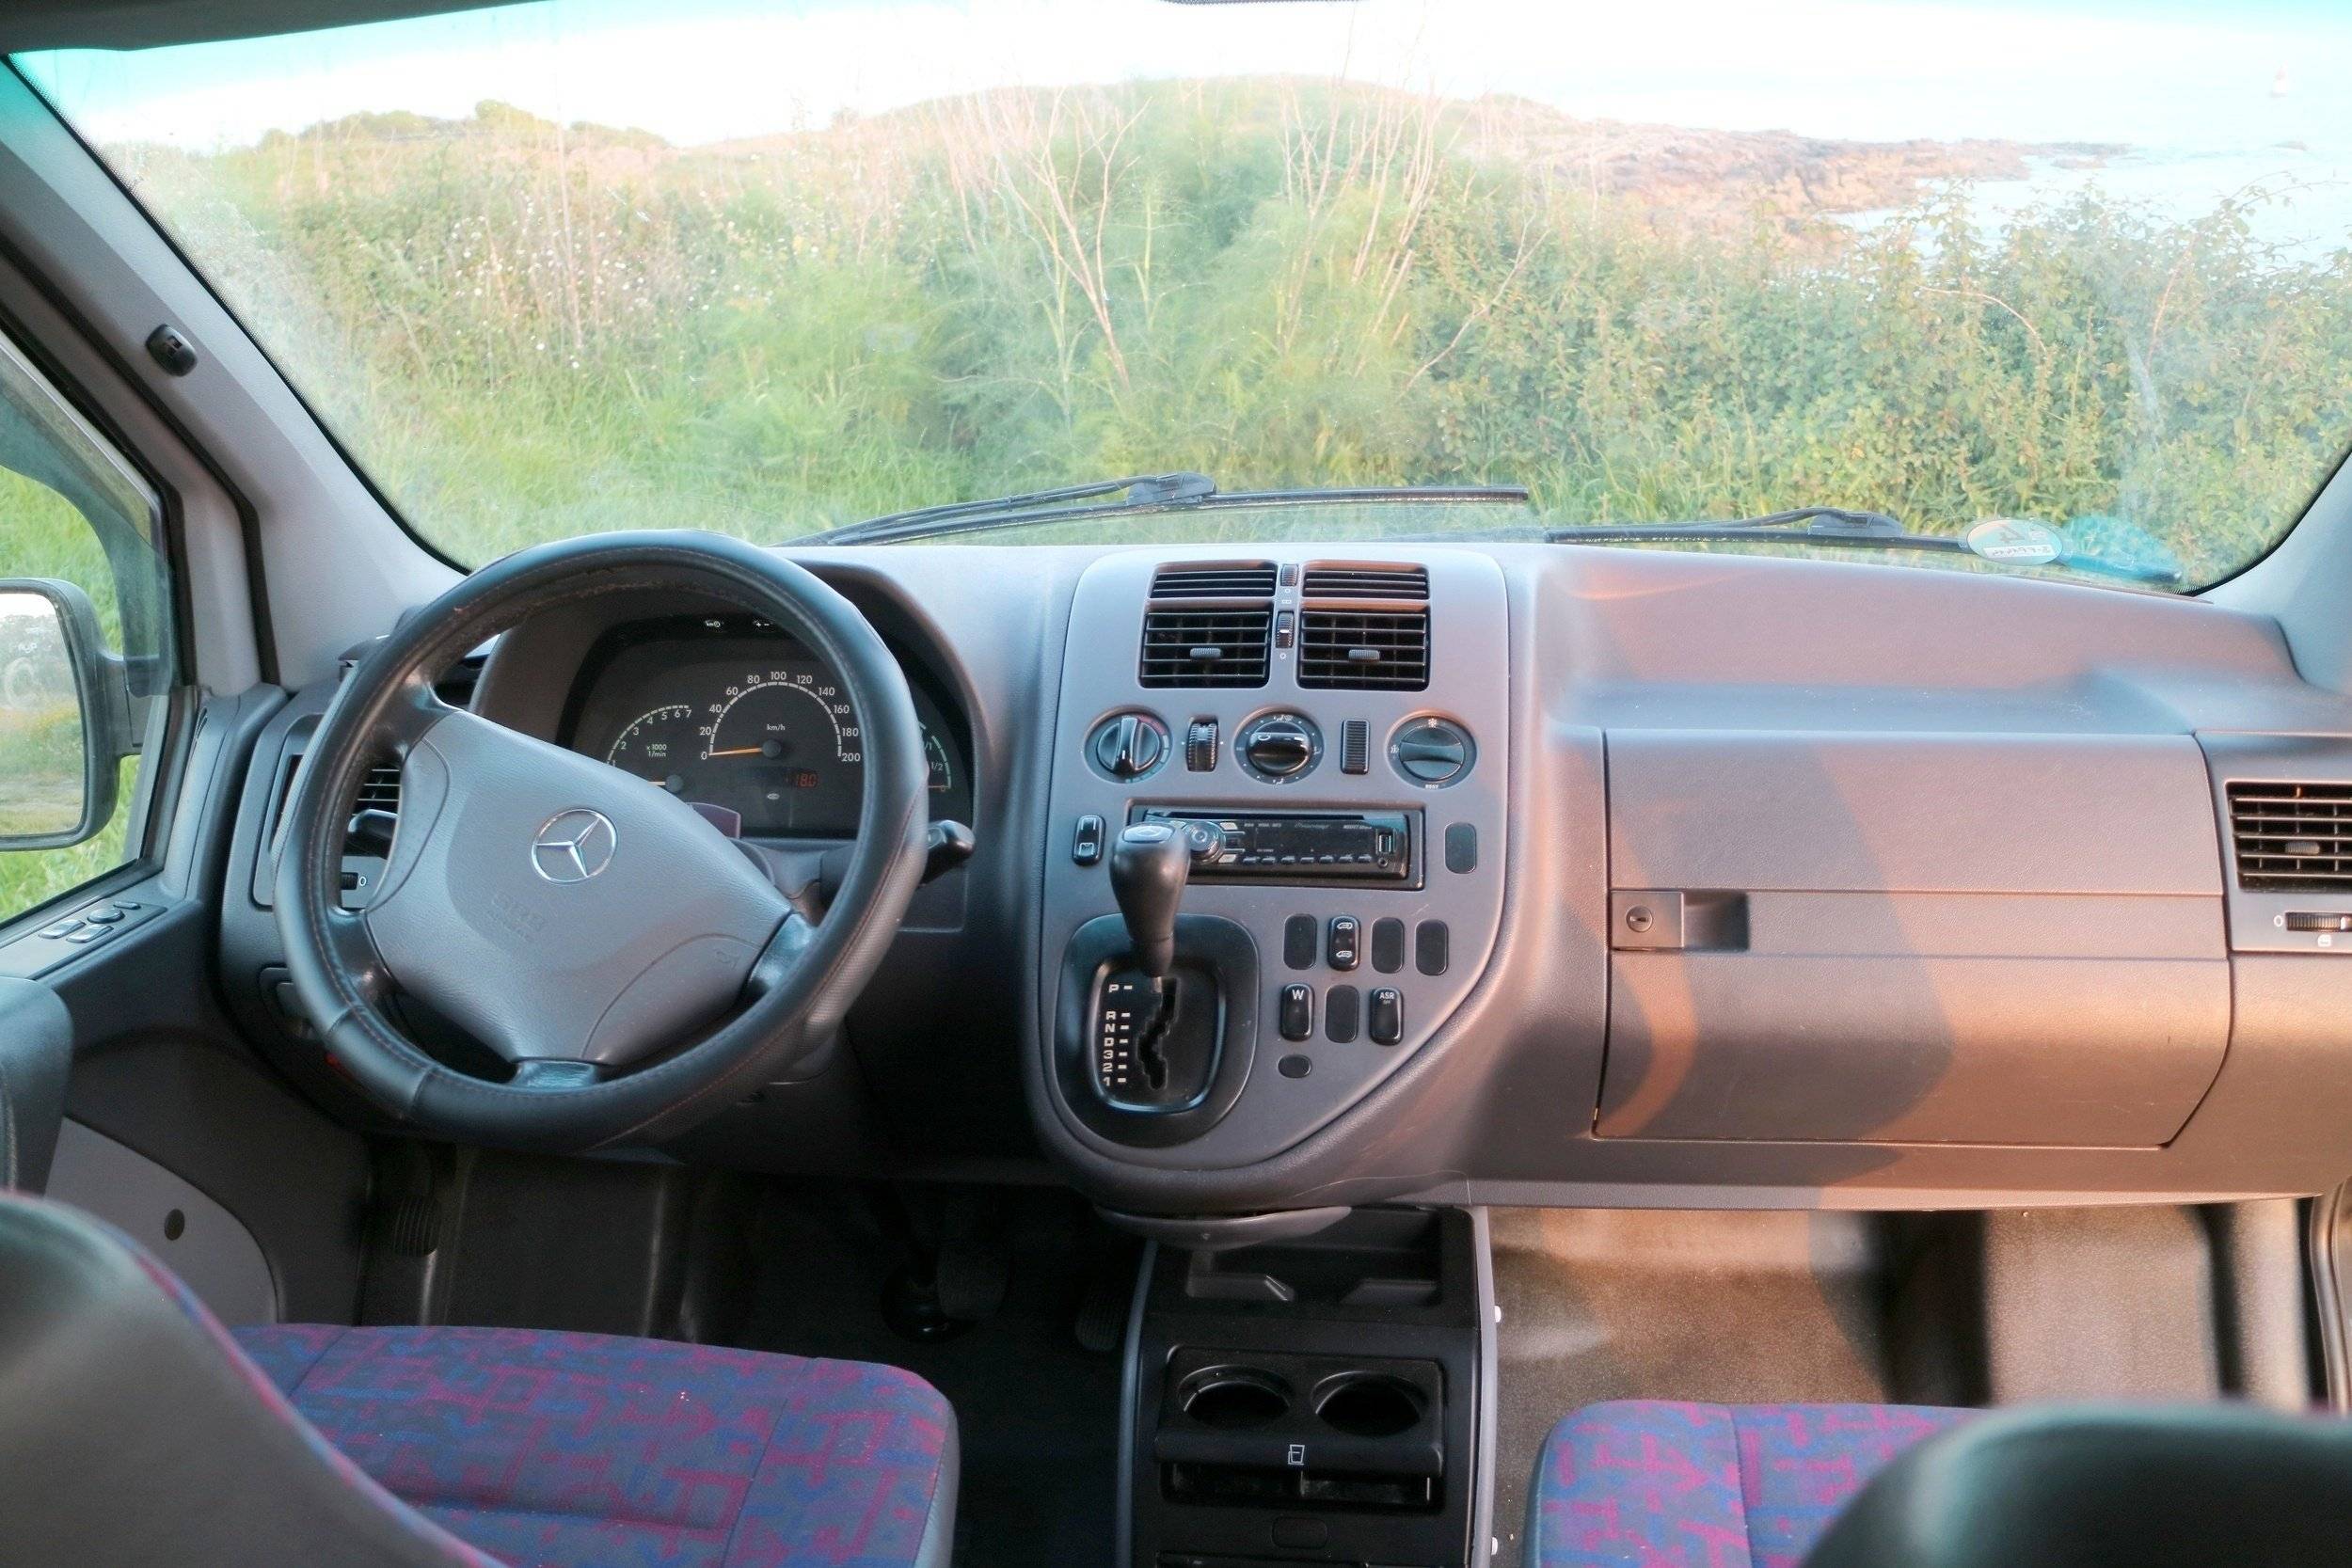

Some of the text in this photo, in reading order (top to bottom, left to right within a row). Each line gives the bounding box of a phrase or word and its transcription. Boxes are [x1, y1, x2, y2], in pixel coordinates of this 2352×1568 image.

[747, 675, 760, 684] 80
[771, 672, 787, 680] 100
[797, 675, 813, 684] 120
[725, 687, 739, 696] 60
[818, 688, 835, 696] 140
[686, 709, 692, 718] 7
[708, 705, 722, 713] 40
[834, 705, 850, 714] 160
[647, 717, 653, 725] 4
[661, 712, 667, 721] 5
[633, 727, 639, 736] 3
[699, 727, 712, 736] 20
[842, 728, 859, 736] 180
[621, 741, 627, 750] 2
[700, 752, 707, 760] 0
[841, 752, 861, 762] 200
[930, 762, 944, 771] 1/2
[1108, 984, 1120, 993] P
[1292, 989, 1305, 1001] W
[1379, 991, 1394, 1000] ASR
[1105, 1010, 1117, 1020] R
[1104, 1023, 1116, 1033] N
[1104, 1037, 1115, 1047] D
[1103, 1050, 1114, 1059] 3
[1102, 1062, 1113, 1072] 2
[1103, 1076, 1111, 1086] 1
